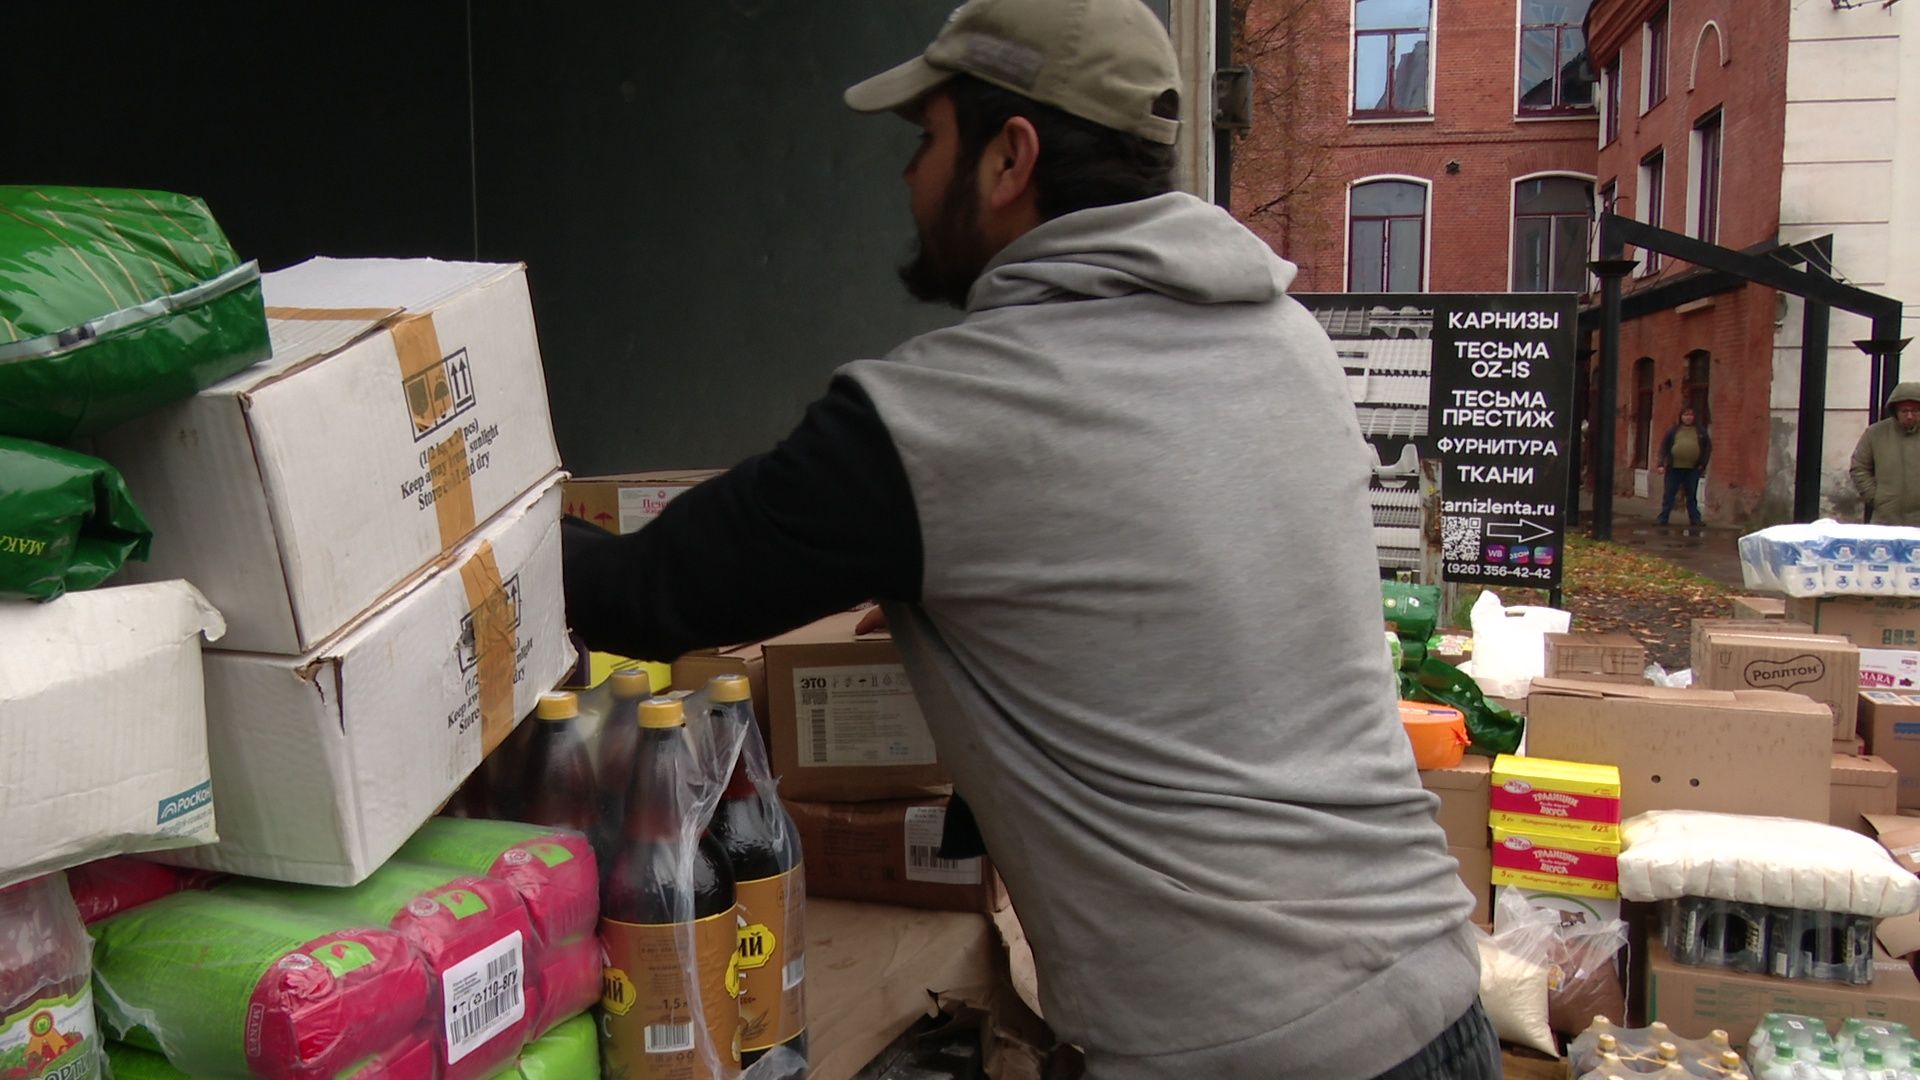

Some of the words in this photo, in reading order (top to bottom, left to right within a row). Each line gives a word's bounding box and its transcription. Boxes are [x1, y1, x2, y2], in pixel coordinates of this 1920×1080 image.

[1449, 311, 1559, 330] КАРНИЗЫ
[1454, 341, 1549, 360] ТЕСЬМА
[1471, 361, 1530, 378] OZ-IS
[1452, 389, 1547, 409] ТЕСЬМА
[1442, 408, 1555, 428] ПРЕСТИЖ
[1437, 436, 1558, 457] ФУРНИТУРА
[401, 476, 424, 500] Keep
[469, 424, 499, 453] sunlight
[418, 484, 443, 511] Store
[477, 451, 489, 471] dry
[1457, 465, 1534, 485] ТКАНИ
[1487, 549, 1503, 558] WB
[1447, 563, 1481, 575] (926)
[1483, 565, 1551, 579] 356-42-42
[800, 677, 827, 689] ЭТО
[447, 703, 466, 729] Keep
[1540, 805, 1568, 816] ВКУСА
[1540, 863, 1568, 874] ВКУСА
